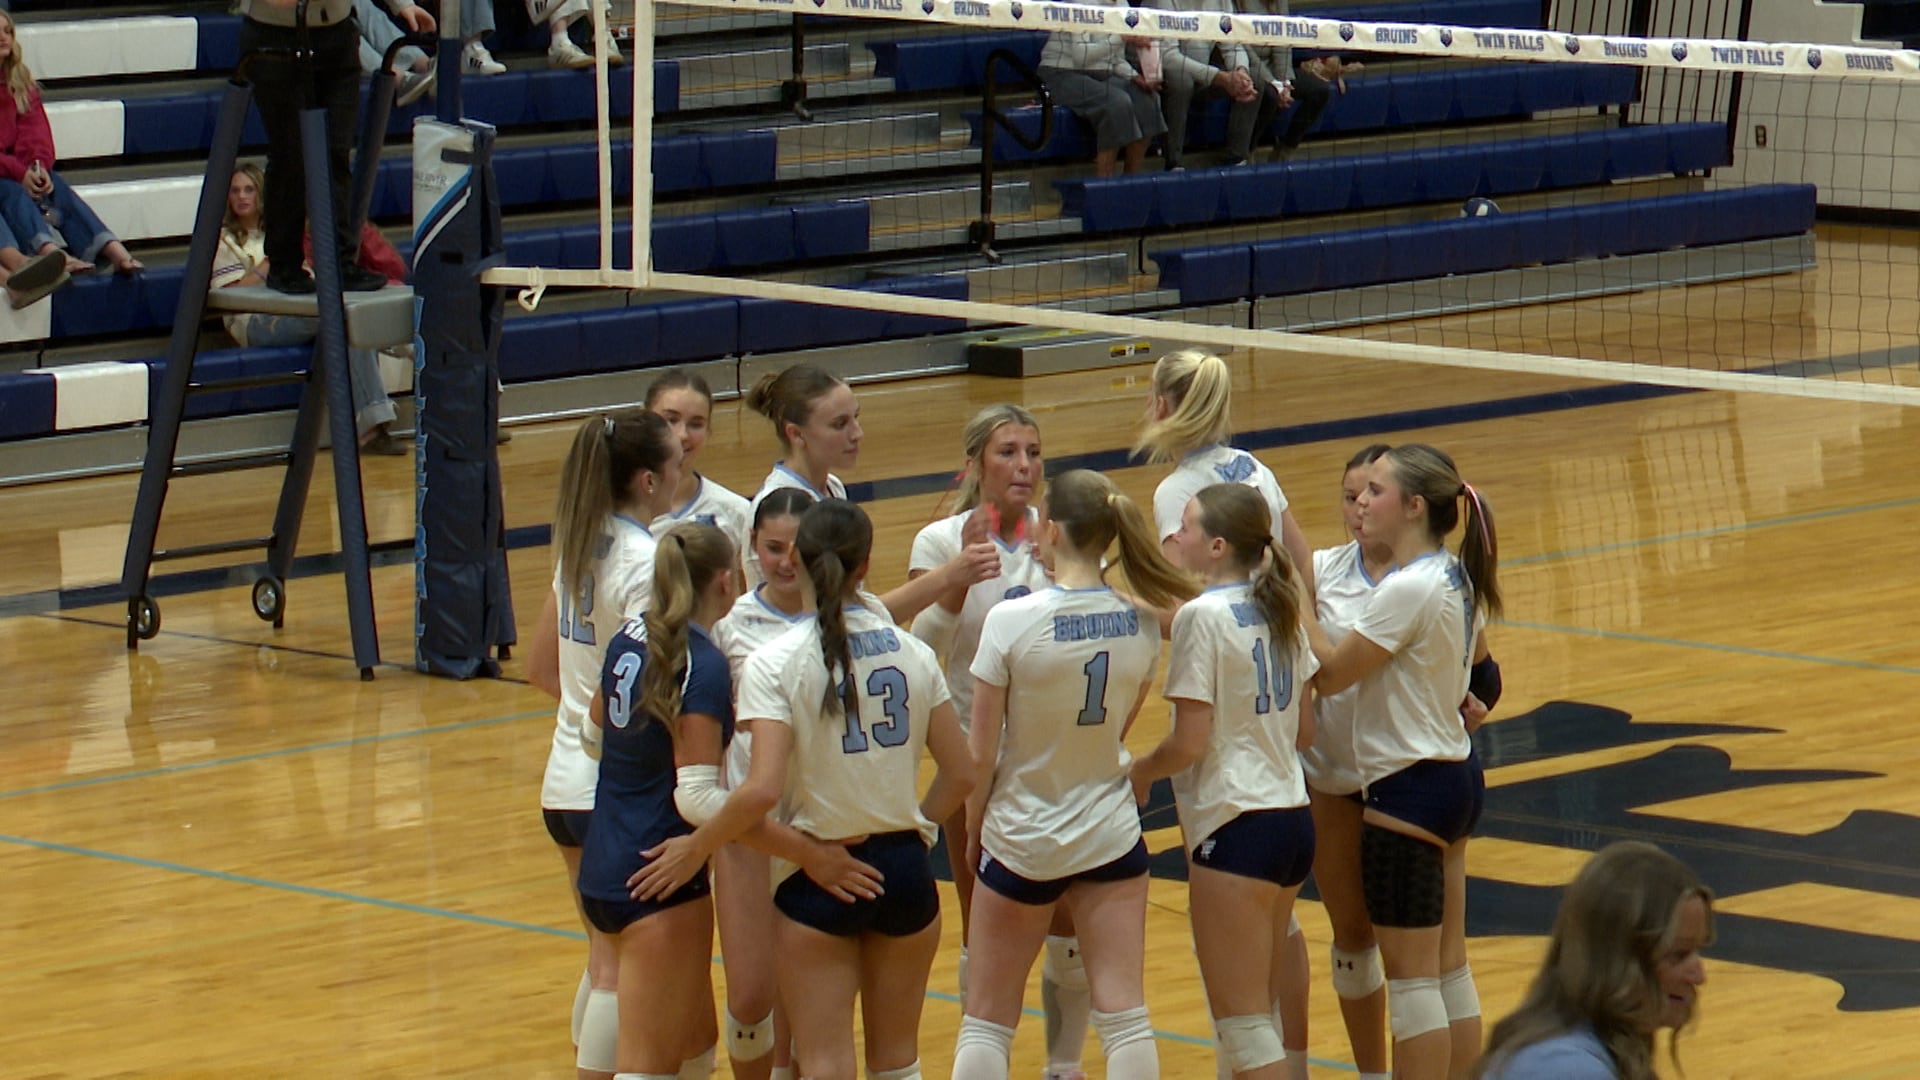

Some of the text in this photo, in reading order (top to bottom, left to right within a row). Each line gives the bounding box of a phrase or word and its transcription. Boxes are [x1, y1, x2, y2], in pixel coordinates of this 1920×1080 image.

[954, 1, 991, 17] BRUINS
[1043, 6, 1105, 24] TWIN FALLS
[1158, 15, 1199, 32] BRUINS
[1252, 20, 1318, 38] TWIN FALLS
[1375, 27, 1417, 44] BRUINS
[1473, 32, 1544, 51] TWIN FALLS
[1603, 40, 1648, 59] BRUINS
[1711, 46, 1785, 66] TWIN FALLS
[1845, 53, 1894, 72] BRUINS
[1053, 609, 1139, 642] BRUINS
[847, 627, 901, 660] UINS
[1252, 637, 1294, 715] 10
[608, 651, 643, 730] 3
[1077, 651, 1110, 727] 1
[838, 665, 910, 754] 13
